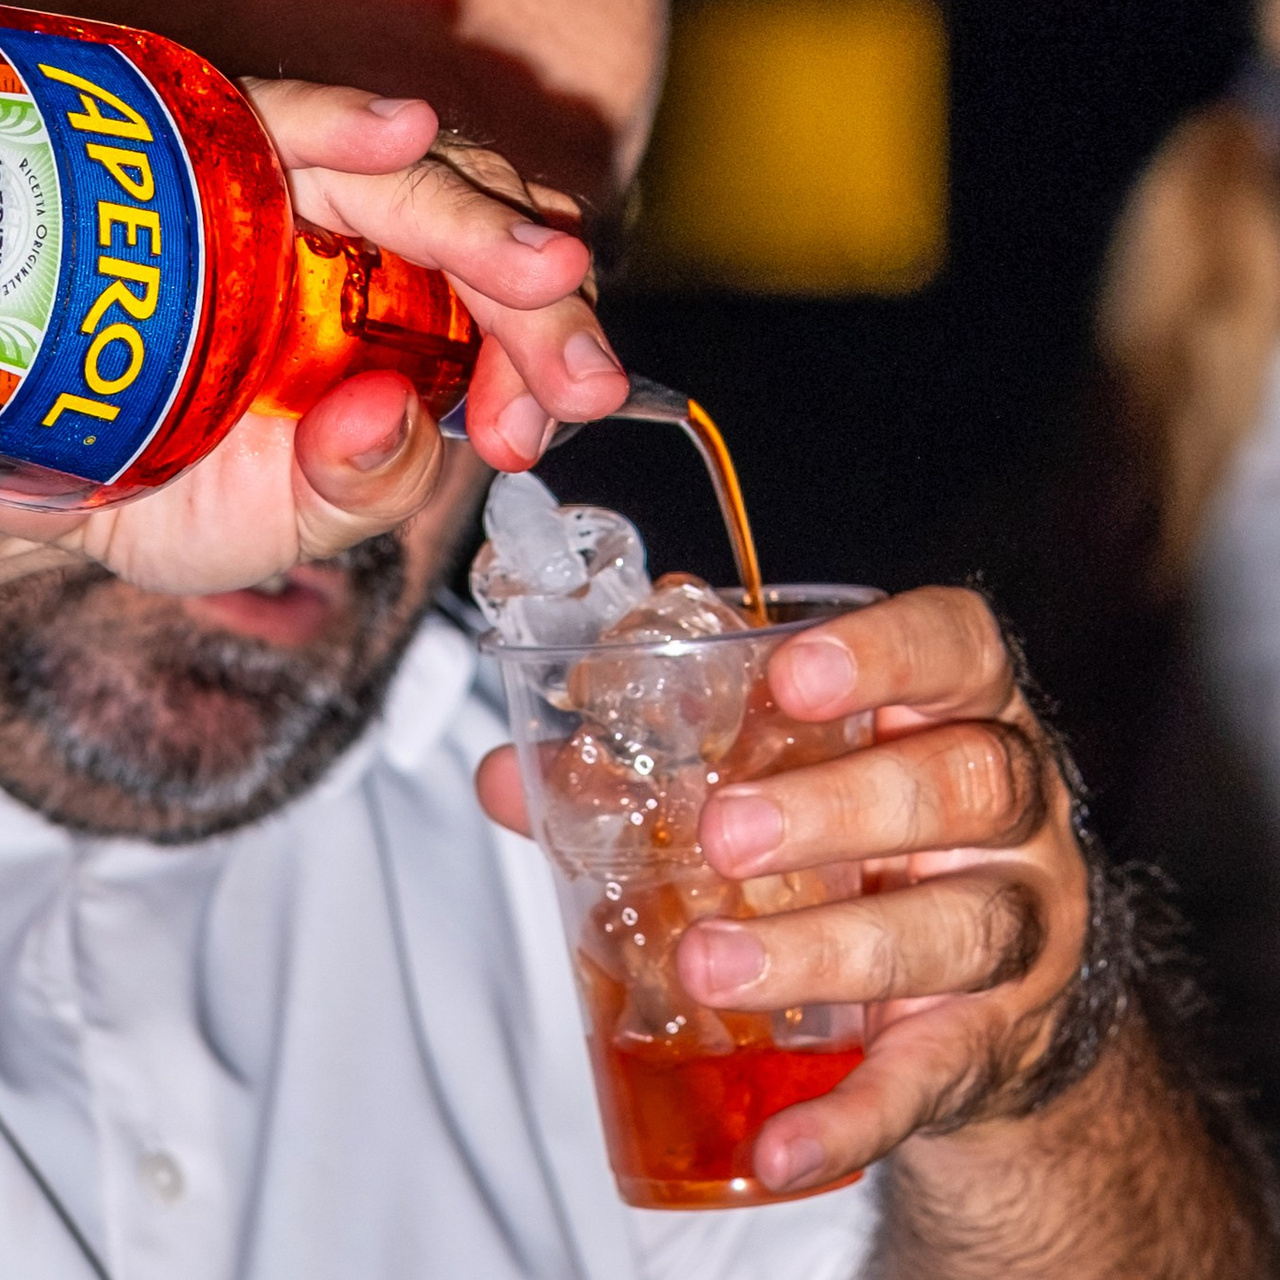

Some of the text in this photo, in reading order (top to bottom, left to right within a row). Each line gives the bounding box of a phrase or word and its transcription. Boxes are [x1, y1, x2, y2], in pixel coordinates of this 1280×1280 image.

[2, 157, 48, 297] RICETTA ORIGINALE
[36, 63, 162, 428] APEROL
